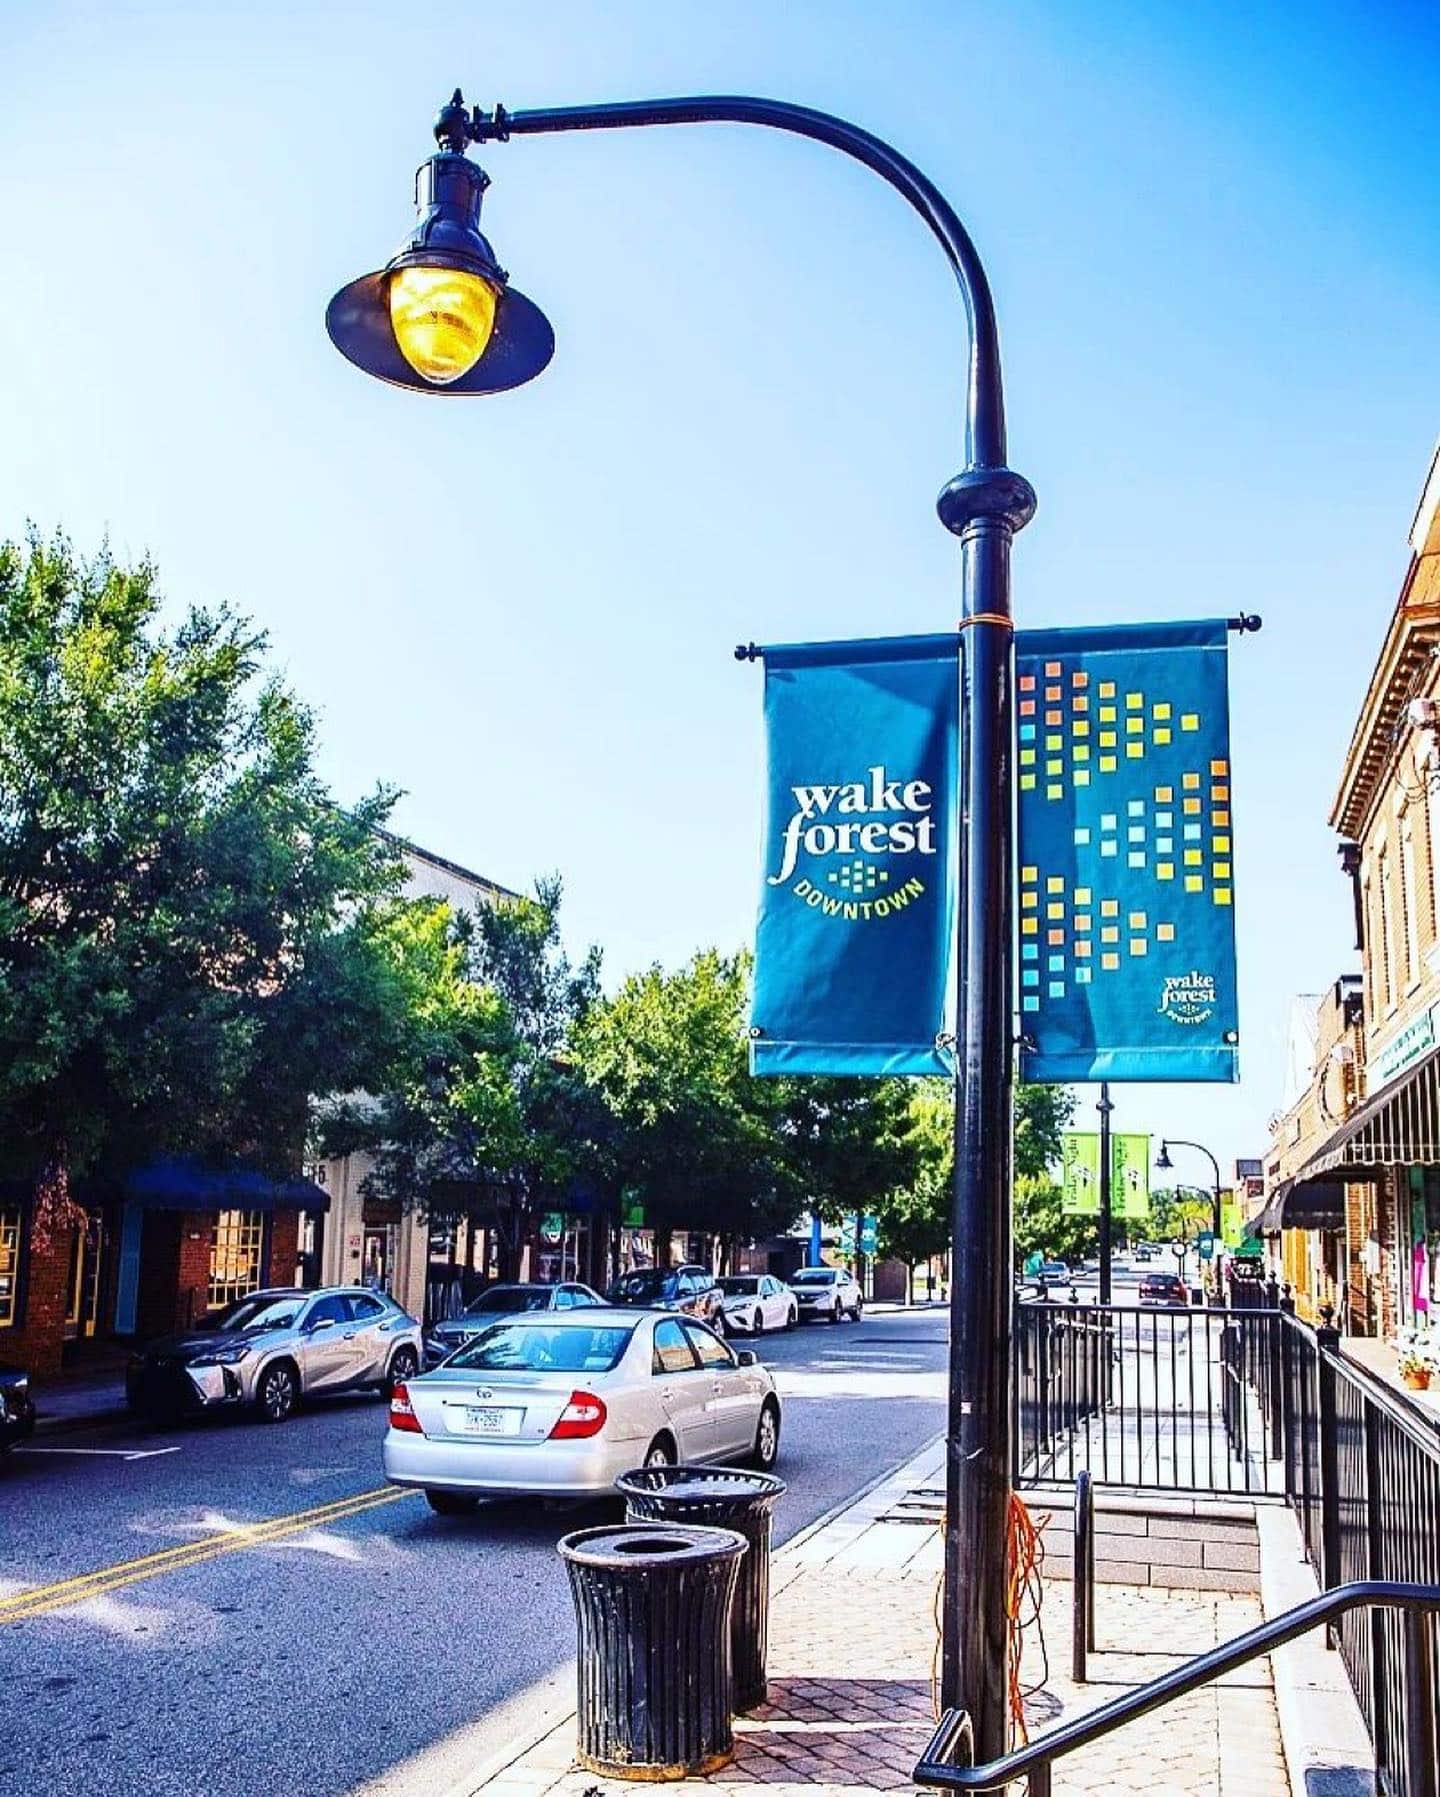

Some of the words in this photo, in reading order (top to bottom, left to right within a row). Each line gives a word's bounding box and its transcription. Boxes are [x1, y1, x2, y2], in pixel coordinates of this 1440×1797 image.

[791, 766, 932, 814] wake
[767, 811, 937, 886] forest
[793, 877, 926, 920] DOWNTOWN
[1157, 987, 1216, 1013] forest
[1164, 970, 1214, 989] wake
